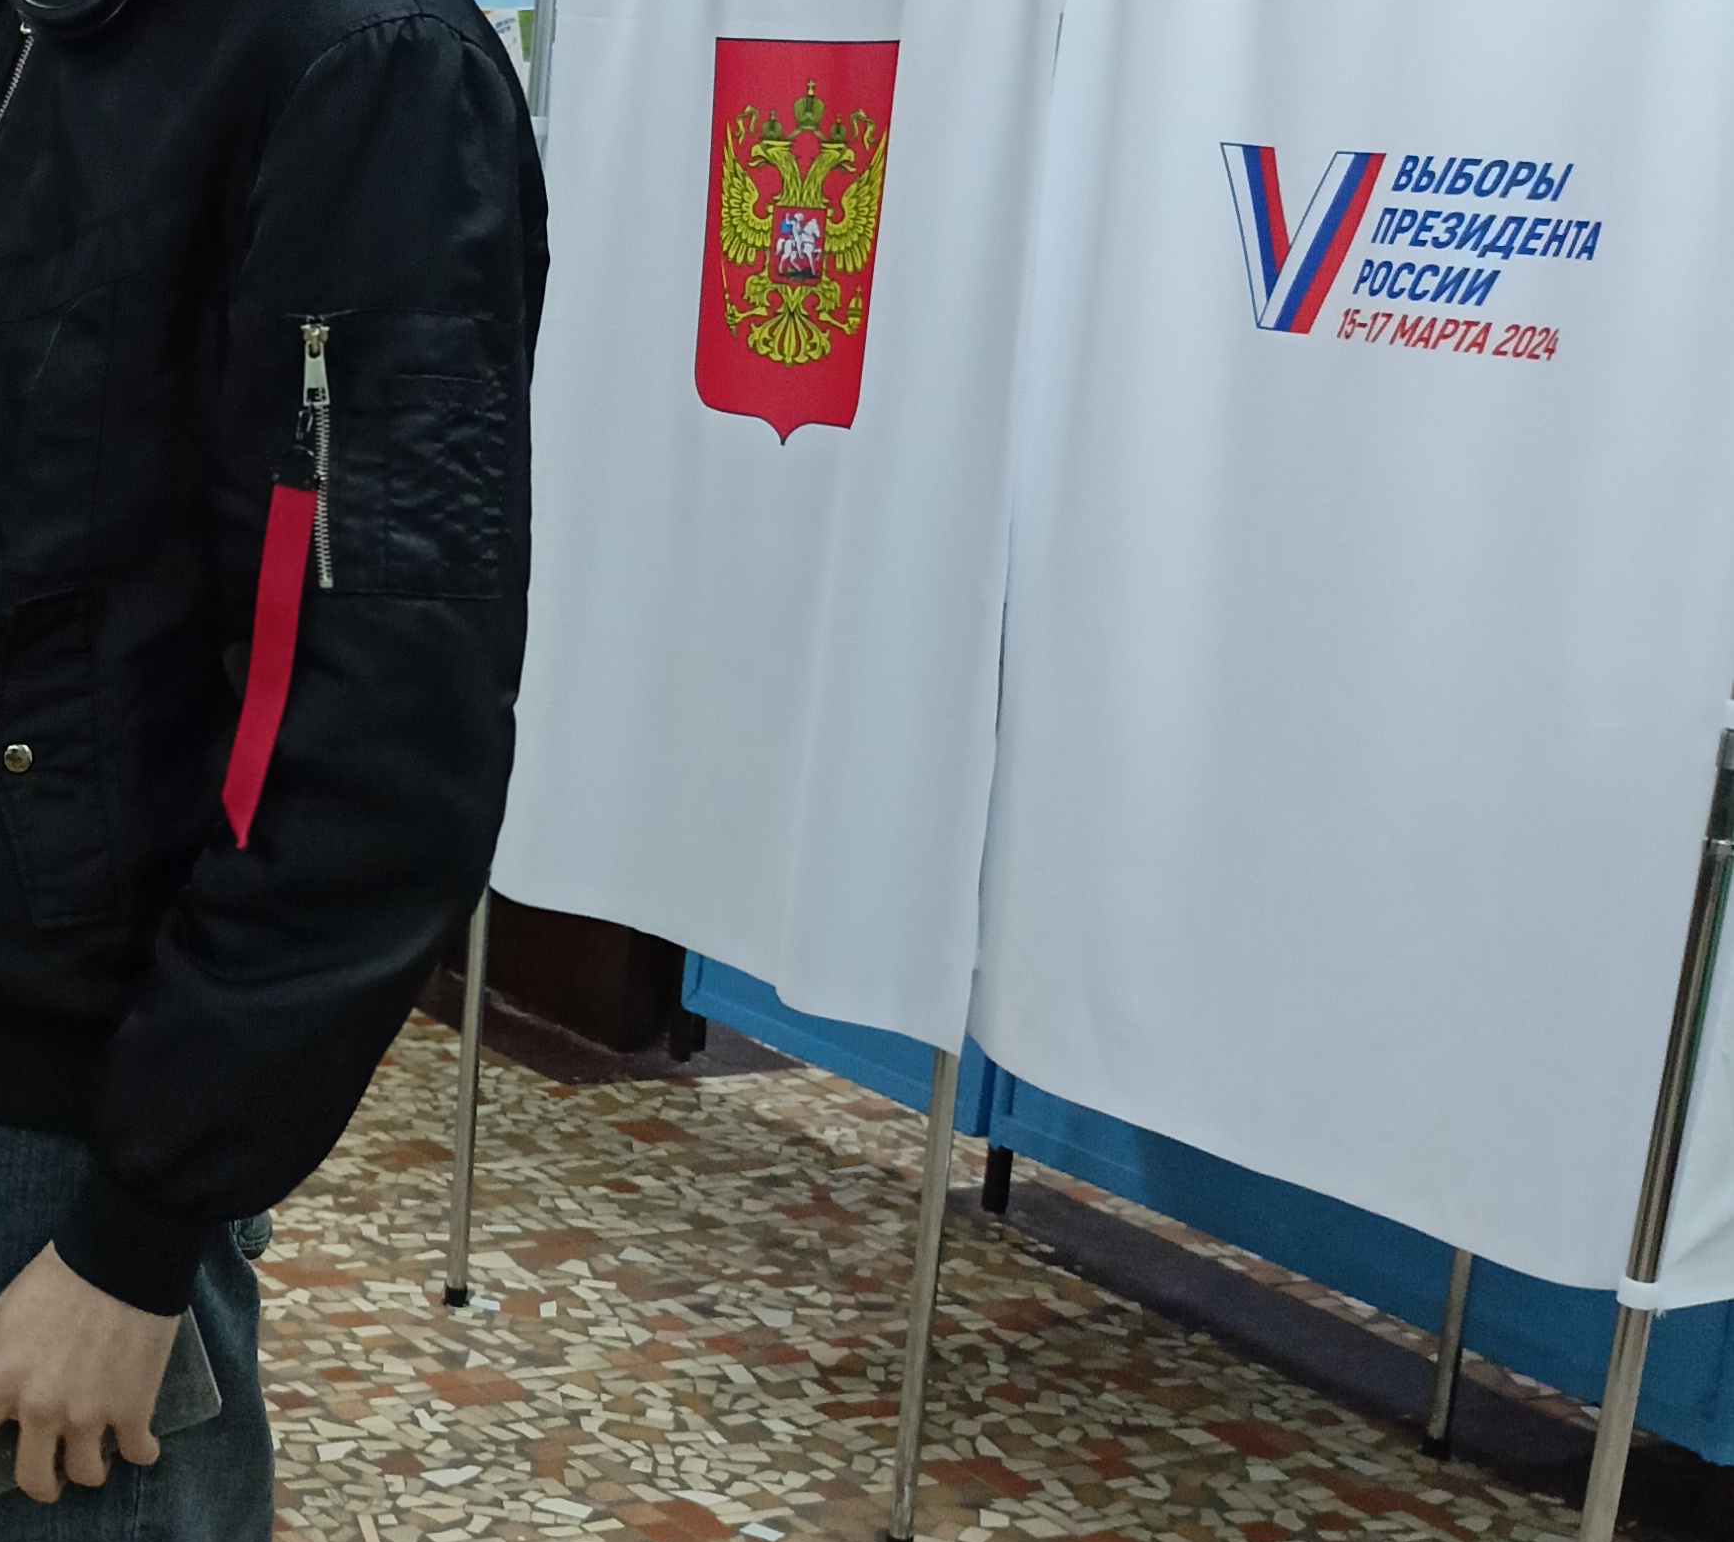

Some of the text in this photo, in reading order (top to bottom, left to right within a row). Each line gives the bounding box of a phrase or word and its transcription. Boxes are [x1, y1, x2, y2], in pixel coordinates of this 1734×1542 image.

[1391, 154, 1574, 202] ВЫБОРЫ
[1371, 207, 1602, 261] ПРЕЗИДЕНТА
[1352, 258, 1501, 307] РОССИИ
[1389, 313, 1493, 354] МАРТА
[1492, 324, 1561, 361] 2024
